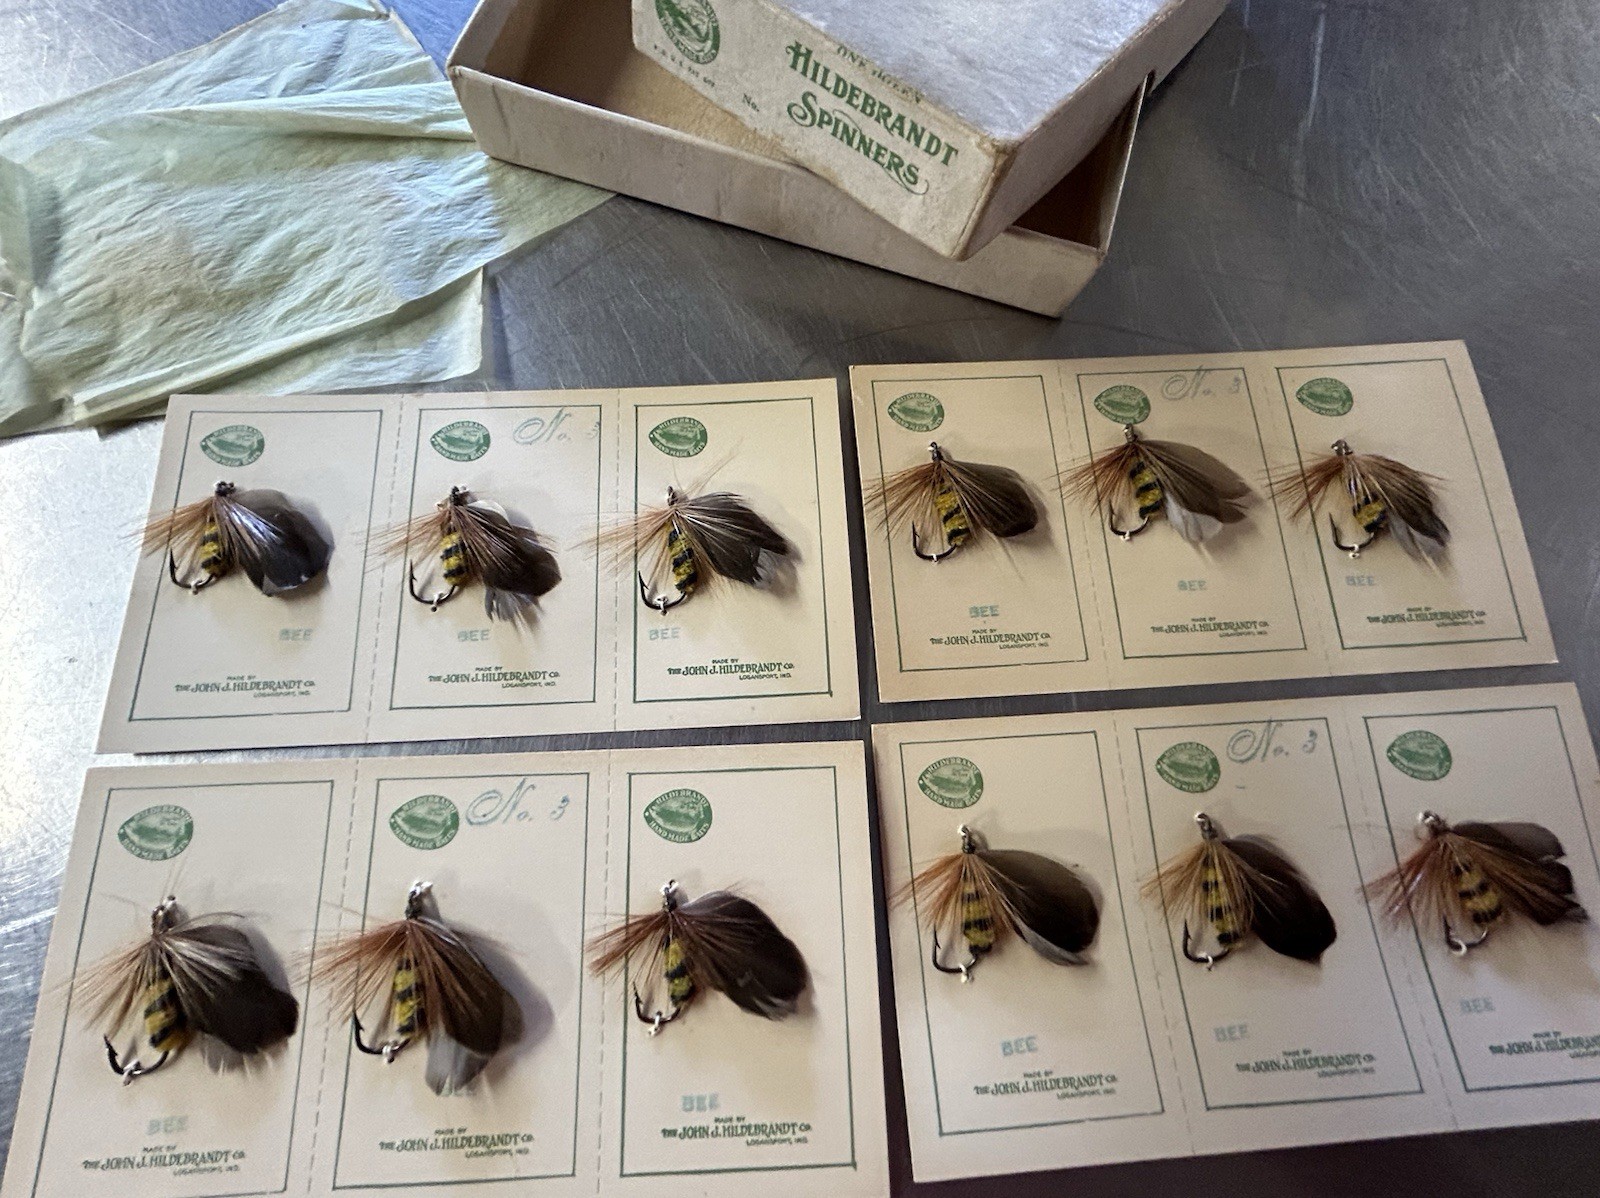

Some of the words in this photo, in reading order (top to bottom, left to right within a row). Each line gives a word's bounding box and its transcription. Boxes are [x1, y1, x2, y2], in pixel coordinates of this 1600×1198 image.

[785, 40, 959, 166] HILDEBRANDT
[786, 91, 930, 195] SPINNERS
[649, 628, 681, 640] BEE
[1165, 624, 1189, 633] JOHN
[1200, 621, 1257, 631] HILDEBRANDT
[945, 636, 969, 645] JOHN
[970, 636, 979, 644] J.
[980, 633, 1039, 643] HILDEBRANDT
[443, 674, 470, 683] JOHN
[472, 674, 481, 682] J.
[482, 671, 546, 682] HILDEBRANDT
[682, 666, 708, 676] JOHN
[709, 666, 718, 674] J.
[719, 663, 782, 674] HILDEBRANDT
[191, 683, 220, 693] JOHN
[233, 680, 302, 691] HILDEBRANDT
[1226, 716, 1290, 764] No.
[1302, 729, 1318, 753] 3
[466, 778, 536, 826] No.
[551, 795, 570, 821] 3
[655, 789, 709, 807] HILDEBRANDT
[991, 1082, 1020, 1095] JOHN
[1022, 1082, 1032, 1093] J.
[1033, 1075, 1103, 1092] HILDEBRANDT
[679, 1126, 709, 1139] JOHN
[711, 1126, 721, 1138] J.
[722, 1122, 798, 1137] HILDEBRANDT
[397, 1139, 428, 1152] JOHN
[442, 1133, 520, 1149] HILDEBRANDT
[101, 1157, 135, 1170] JOHN
[150, 1151, 231, 1167] HILDEBRANDT
